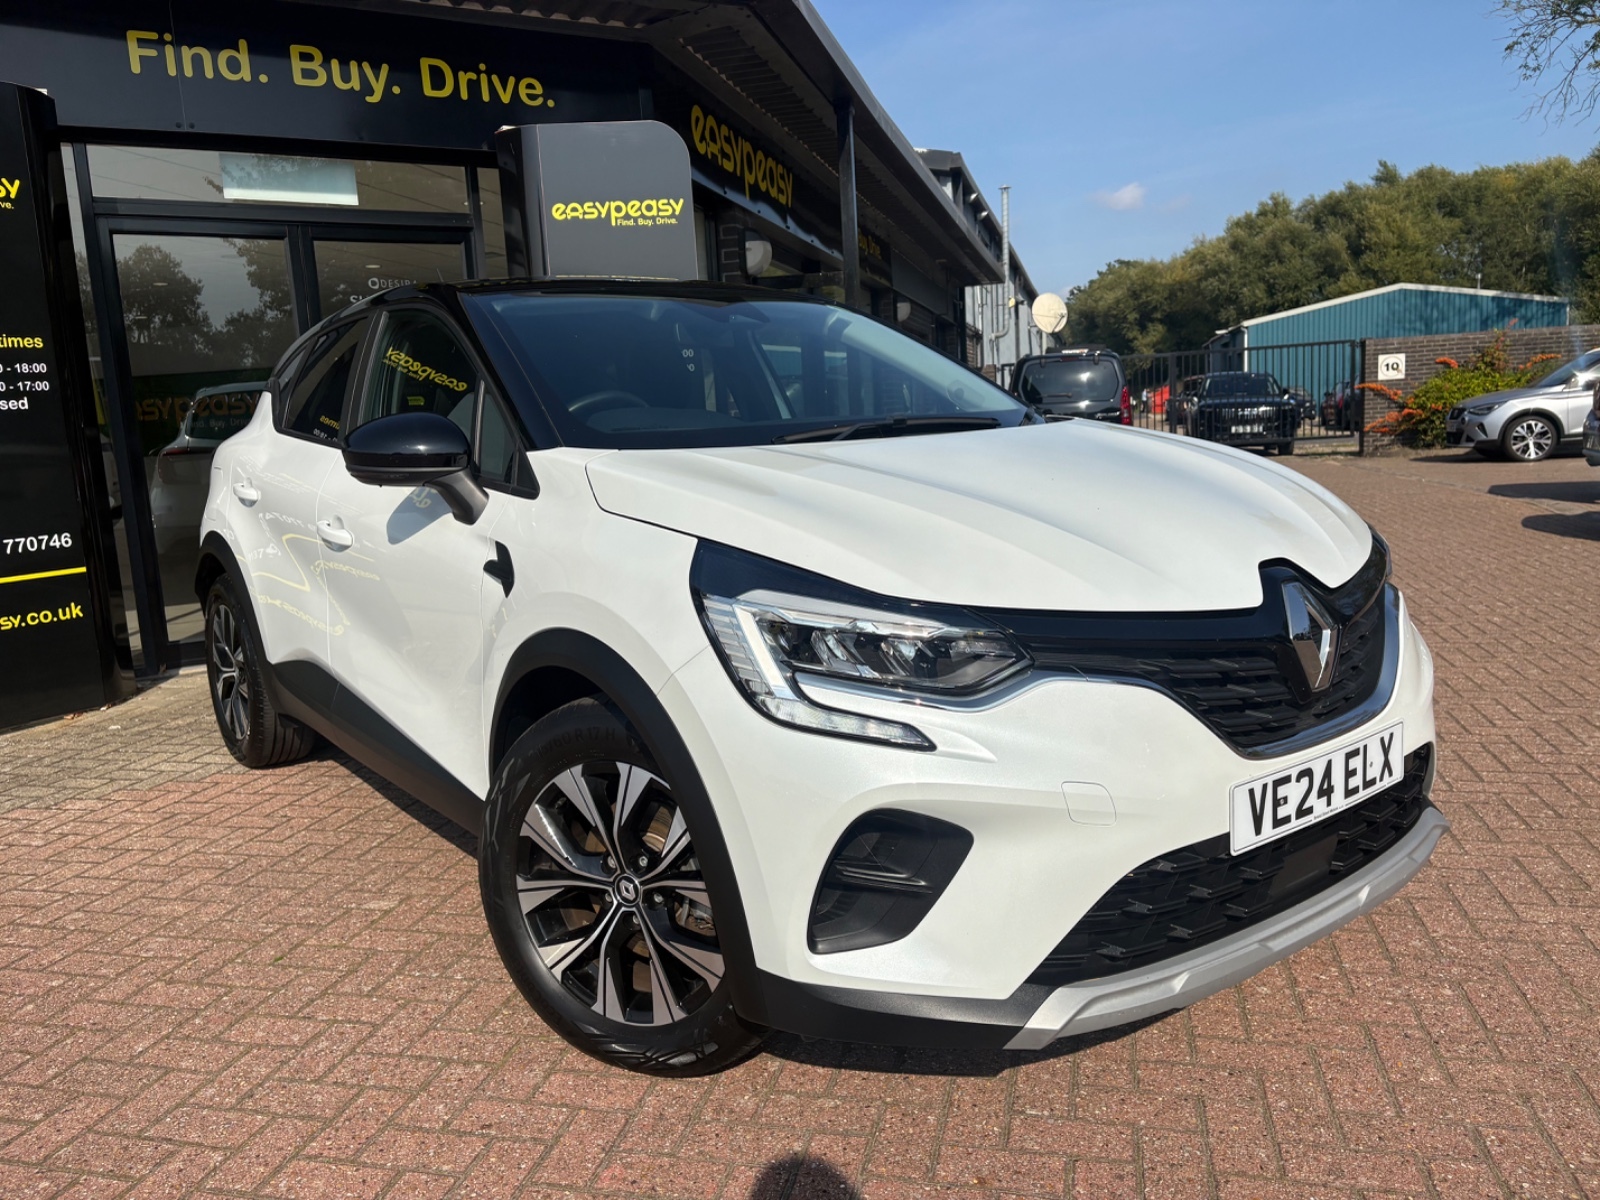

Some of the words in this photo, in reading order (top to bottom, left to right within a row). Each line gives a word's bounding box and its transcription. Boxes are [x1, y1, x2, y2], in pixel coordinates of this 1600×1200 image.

[125, 30, 269, 84] Find.
[289, 44, 401, 103] Buy.
[420, 57, 556, 108] Drive.
[690, 104, 794, 208] easypeasy
[551, 198, 684, 226] easypeasy
[617, 218, 636, 226] Find.
[638, 218, 654, 226] Buy.
[656, 217, 678, 225] Drive.
[14, 362, 47, 374] 18:00
[1384, 361, 1400, 372] 10
[17, 380, 50, 392] 17:00
[0, 396, 29, 410] sed
[2, 532, 73, 555] 770746
[1248, 759, 1335, 837] VE24
[1344, 732, 1394, 800] ELX
